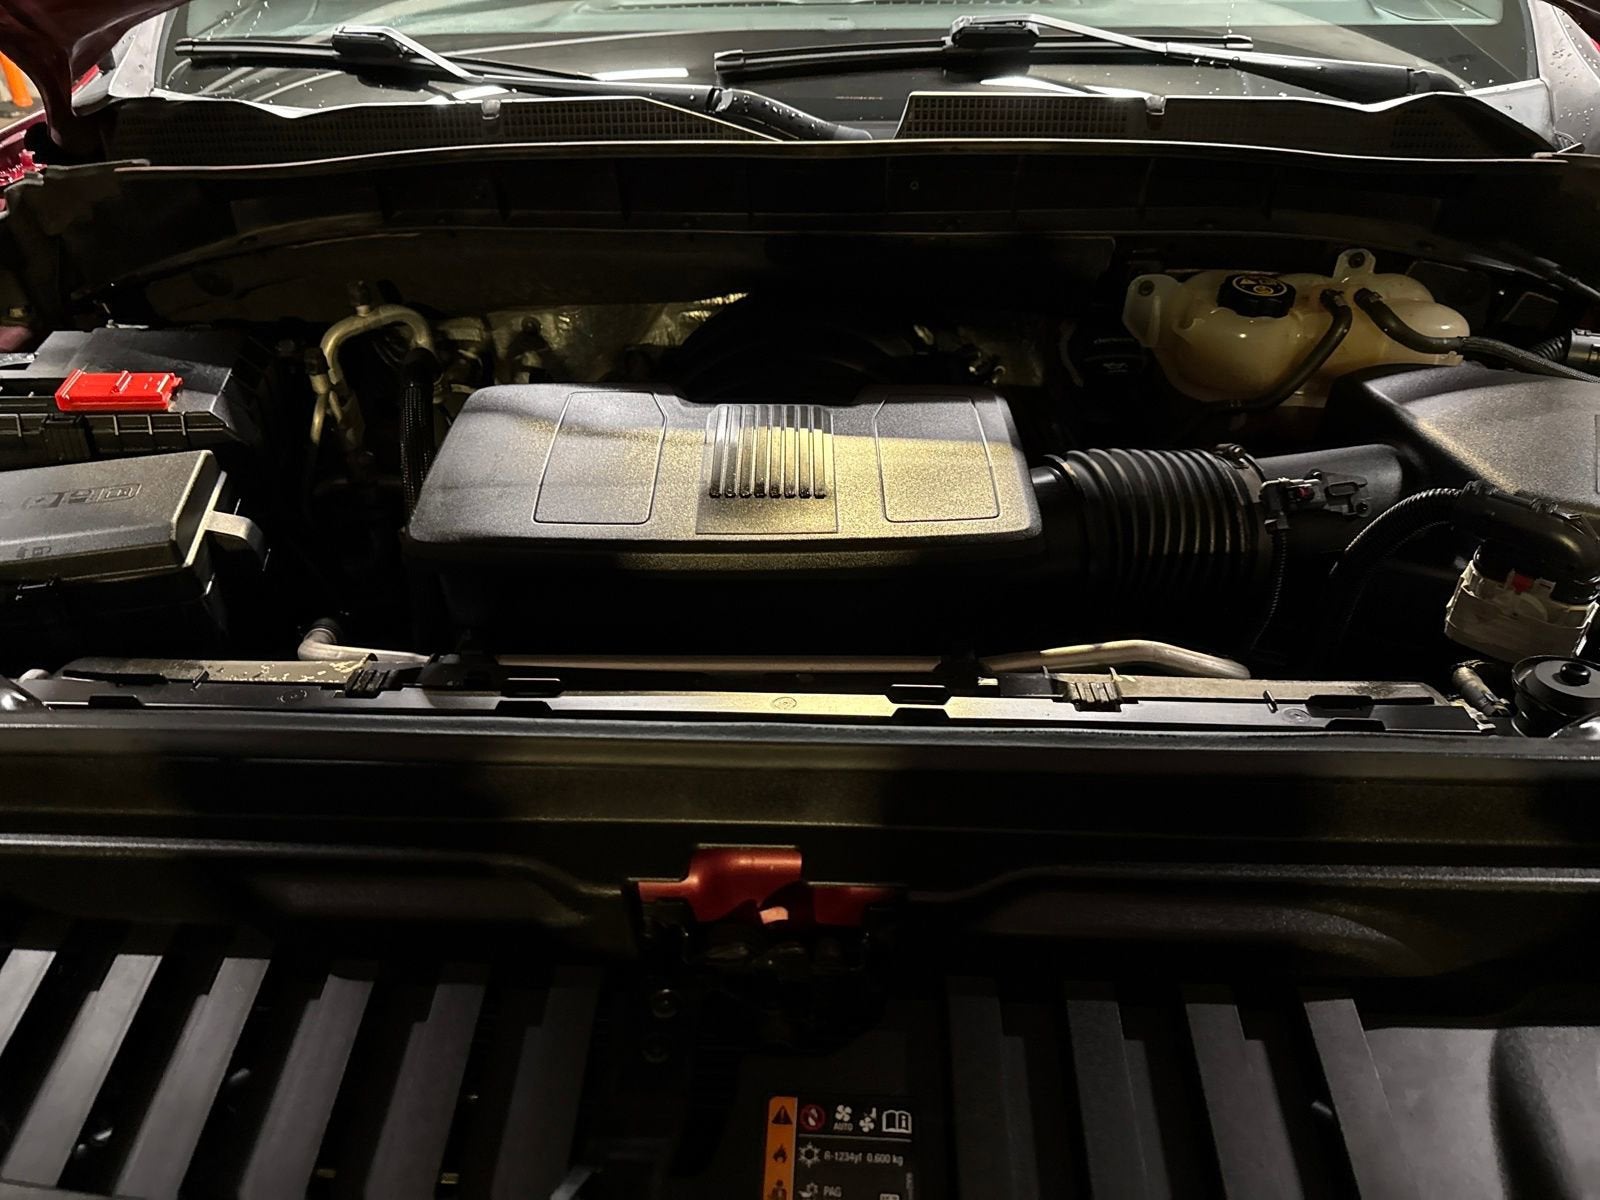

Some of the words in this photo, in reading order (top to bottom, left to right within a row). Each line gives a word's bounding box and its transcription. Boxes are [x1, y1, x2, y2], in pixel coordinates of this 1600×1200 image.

[833, 1122, 854, 1132] AUTO
[892, 1154, 903, 1167] kg
[823, 1185, 842, 1198] PAG
